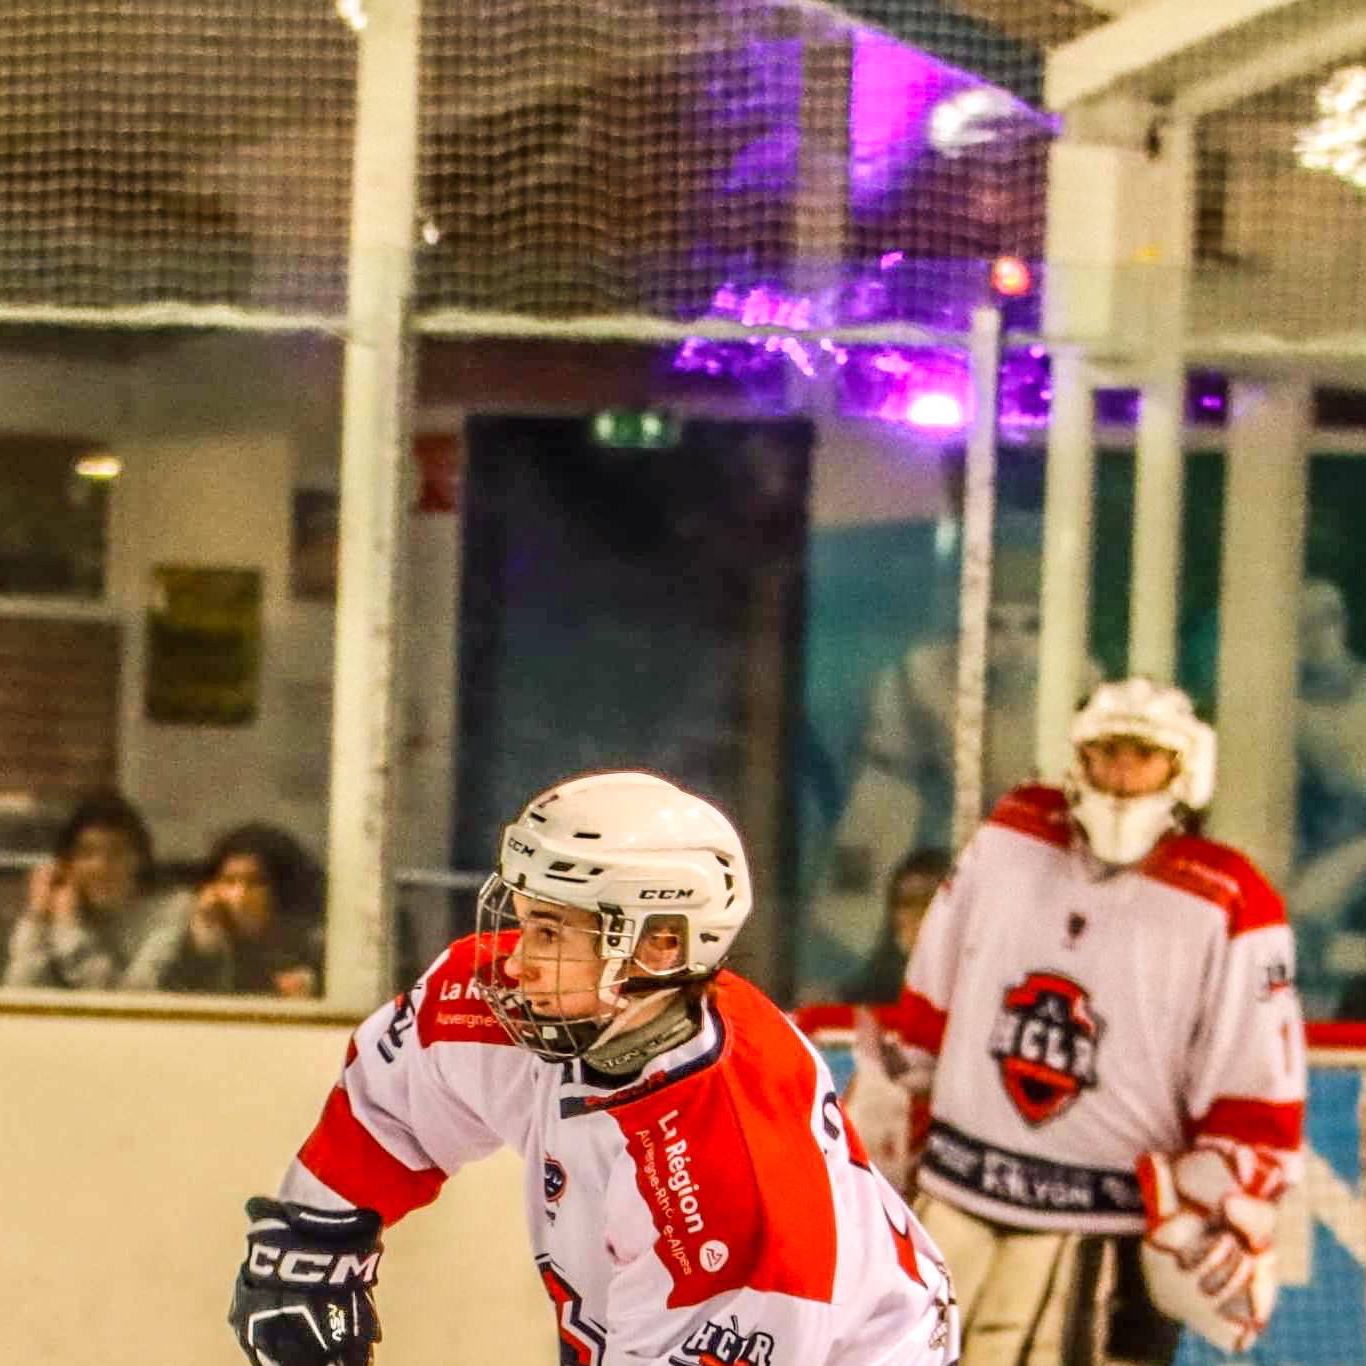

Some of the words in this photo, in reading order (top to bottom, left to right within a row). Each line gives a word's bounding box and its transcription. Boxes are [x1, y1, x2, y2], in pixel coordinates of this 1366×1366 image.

[638, 888, 696, 901] CCM
[438, 979, 463, 1001] La
[635, 1128, 693, 1276] Auvergne-Rhe-Alpes
[665, 1138, 705, 1234] Région
[247, 1241, 380, 1288] CCM
